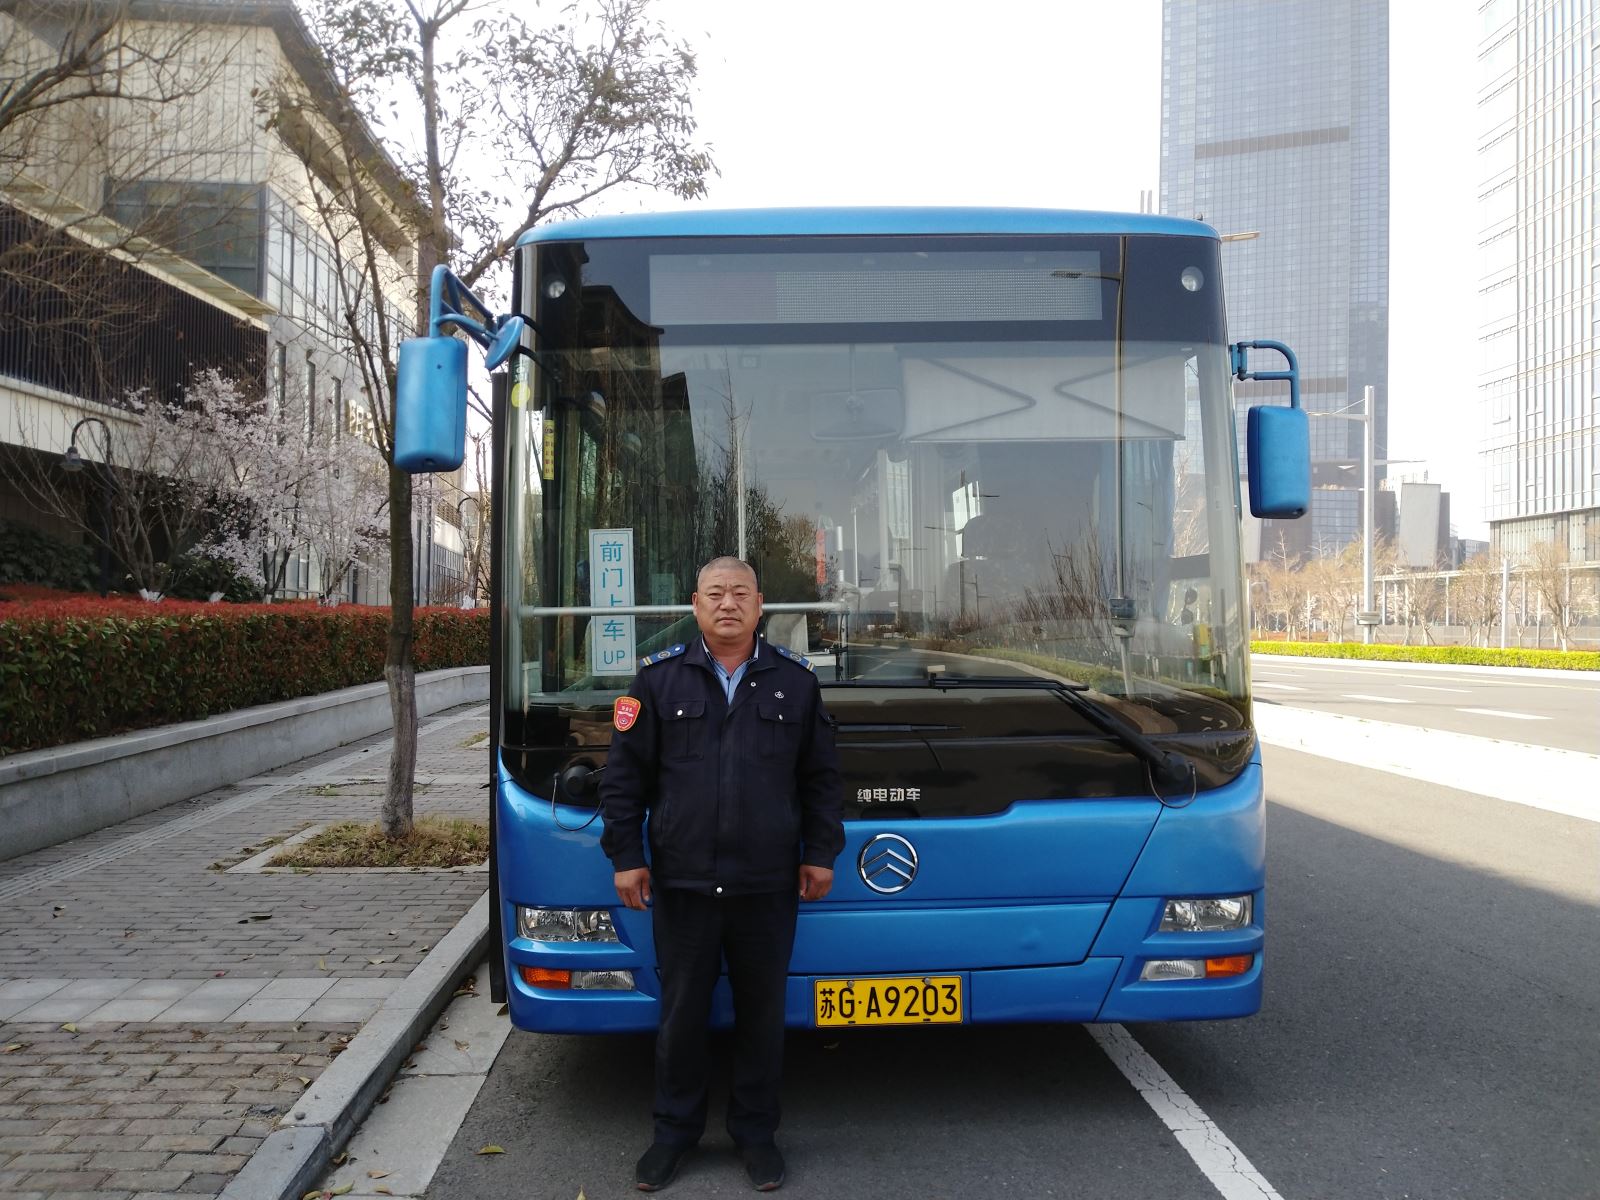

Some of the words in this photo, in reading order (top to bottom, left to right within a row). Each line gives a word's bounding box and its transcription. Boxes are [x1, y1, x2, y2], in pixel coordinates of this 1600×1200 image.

[603, 650, 626, 665] UP
[856, 787, 921, 803] 纯电动车
